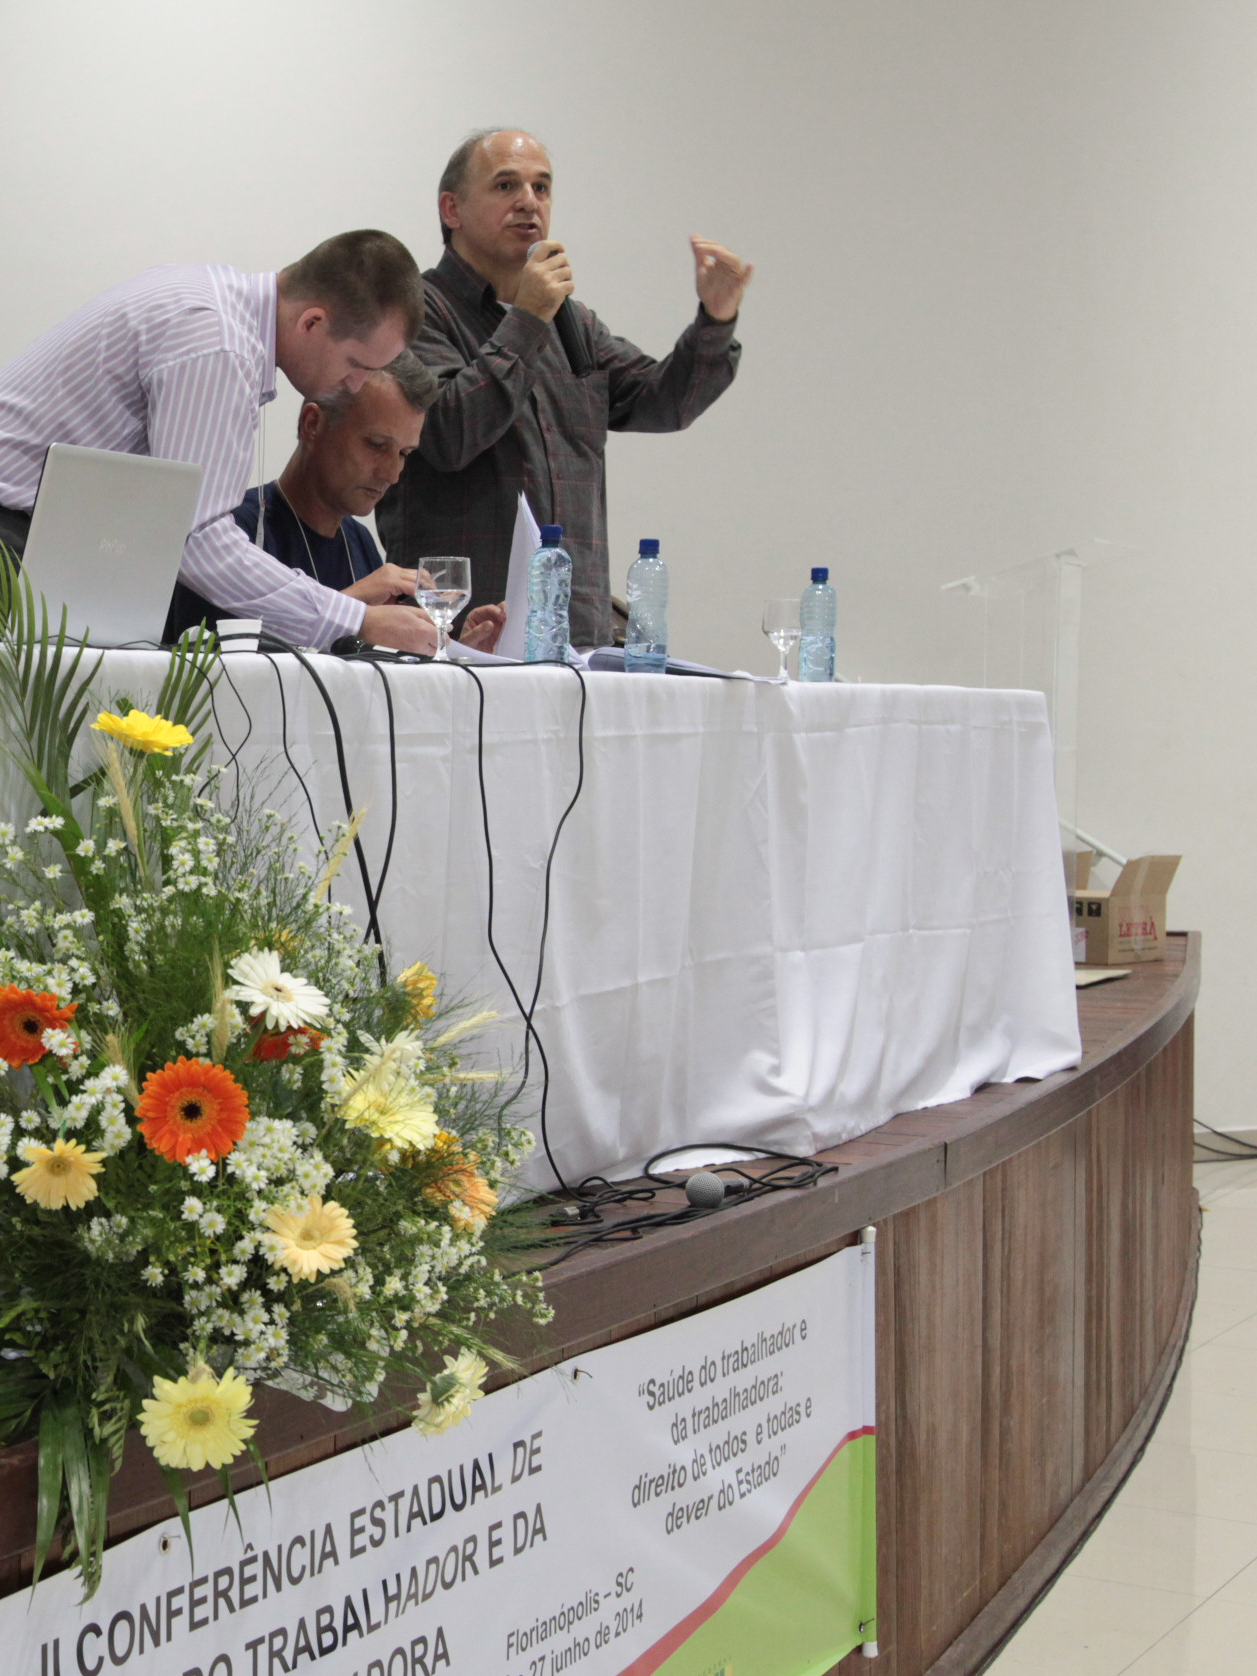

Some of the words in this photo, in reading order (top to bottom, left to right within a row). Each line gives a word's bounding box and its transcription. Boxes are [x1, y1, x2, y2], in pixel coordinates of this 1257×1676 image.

[699, 1355, 717, 1388] do
[721, 1321, 797, 1378] trabalhador
[799, 1318, 808, 1341] e
[670, 1412, 688, 1446] da
[691, 1371, 784, 1436] trabalhadora:
[631, 1462, 688, 1509] direito
[691, 1448, 708, 1483] de
[708, 1430, 748, 1470] todos
[755, 1422, 763, 1446] e
[766, 1401, 802, 1440] todas
[805, 1396, 813, 1419] e
[665, 1492, 715, 1536] dever
[717, 1479, 735, 1512] do
[76, 1522, 340, 1676] CONFERÊNCIA
[349, 1452, 503, 1559] ESTADUAL
[511, 1429, 543, 1485] DE
[244, 1534, 480, 1676] TRABALHADOR
[488, 1520, 504, 1569] E
[513, 1502, 547, 1557] DA
[352, 1625, 451, 1676] ORA
[506, 1589, 601, 1661] Florianópolis
[615, 1566, 635, 1598] SC
[550, 1636, 591, 1676] junho
[594, 1621, 610, 1650] de
[614, 1597, 644, 1639] 2014
